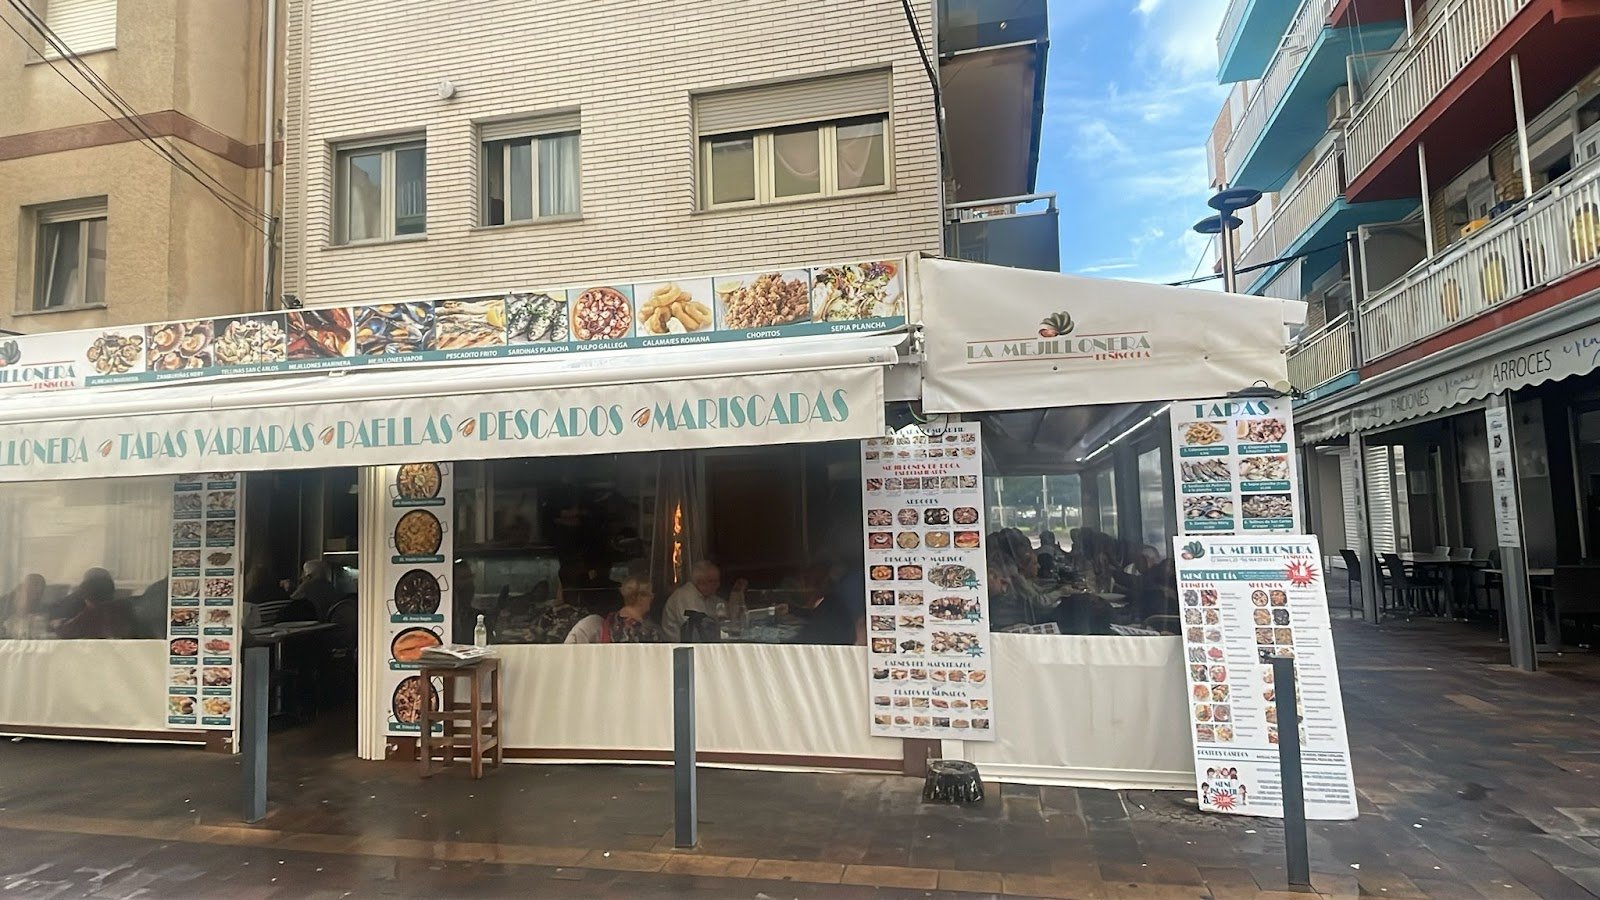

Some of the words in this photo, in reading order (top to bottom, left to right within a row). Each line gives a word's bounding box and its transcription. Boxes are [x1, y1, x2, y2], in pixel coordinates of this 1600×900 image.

[830, 324, 852, 332] SEPIA
[852, 322, 886, 331] PLANCHA
[680, 335, 710, 344] ROMANA
[746, 330, 780, 339] CHOPITOS
[508, 348, 539, 356] SARDINAS
[540, 345, 569, 354] PLANCHA
[576, 344, 598, 354] PULPO
[598, 341, 628, 350] GALLEGA
[967, 344, 993, 359] LA
[1001, 335, 1151, 357] MEJILLONERA
[368, 356, 402, 365] MEJILLONES
[402, 355, 424, 364] VAPOR
[446, 351, 480, 360] PESCADITO
[480, 349, 498, 358] FRITO
[288, 362, 322, 370] MEJILLONES
[1492, 349, 1553, 384] ARROCES
[1194, 400, 1270, 418] TAPAS
[118, 429, 188, 461] TAPAS
[194, 422, 314, 457] VARIADAS
[336, 413, 453, 450] PAELLAS
[479, 404, 624, 442] PESCADOS
[650, 388, 850, 433] MARISCADAS
[1210, 546, 1226, 555] LA
[1230, 546, 1313, 555] MEJILLONERA
